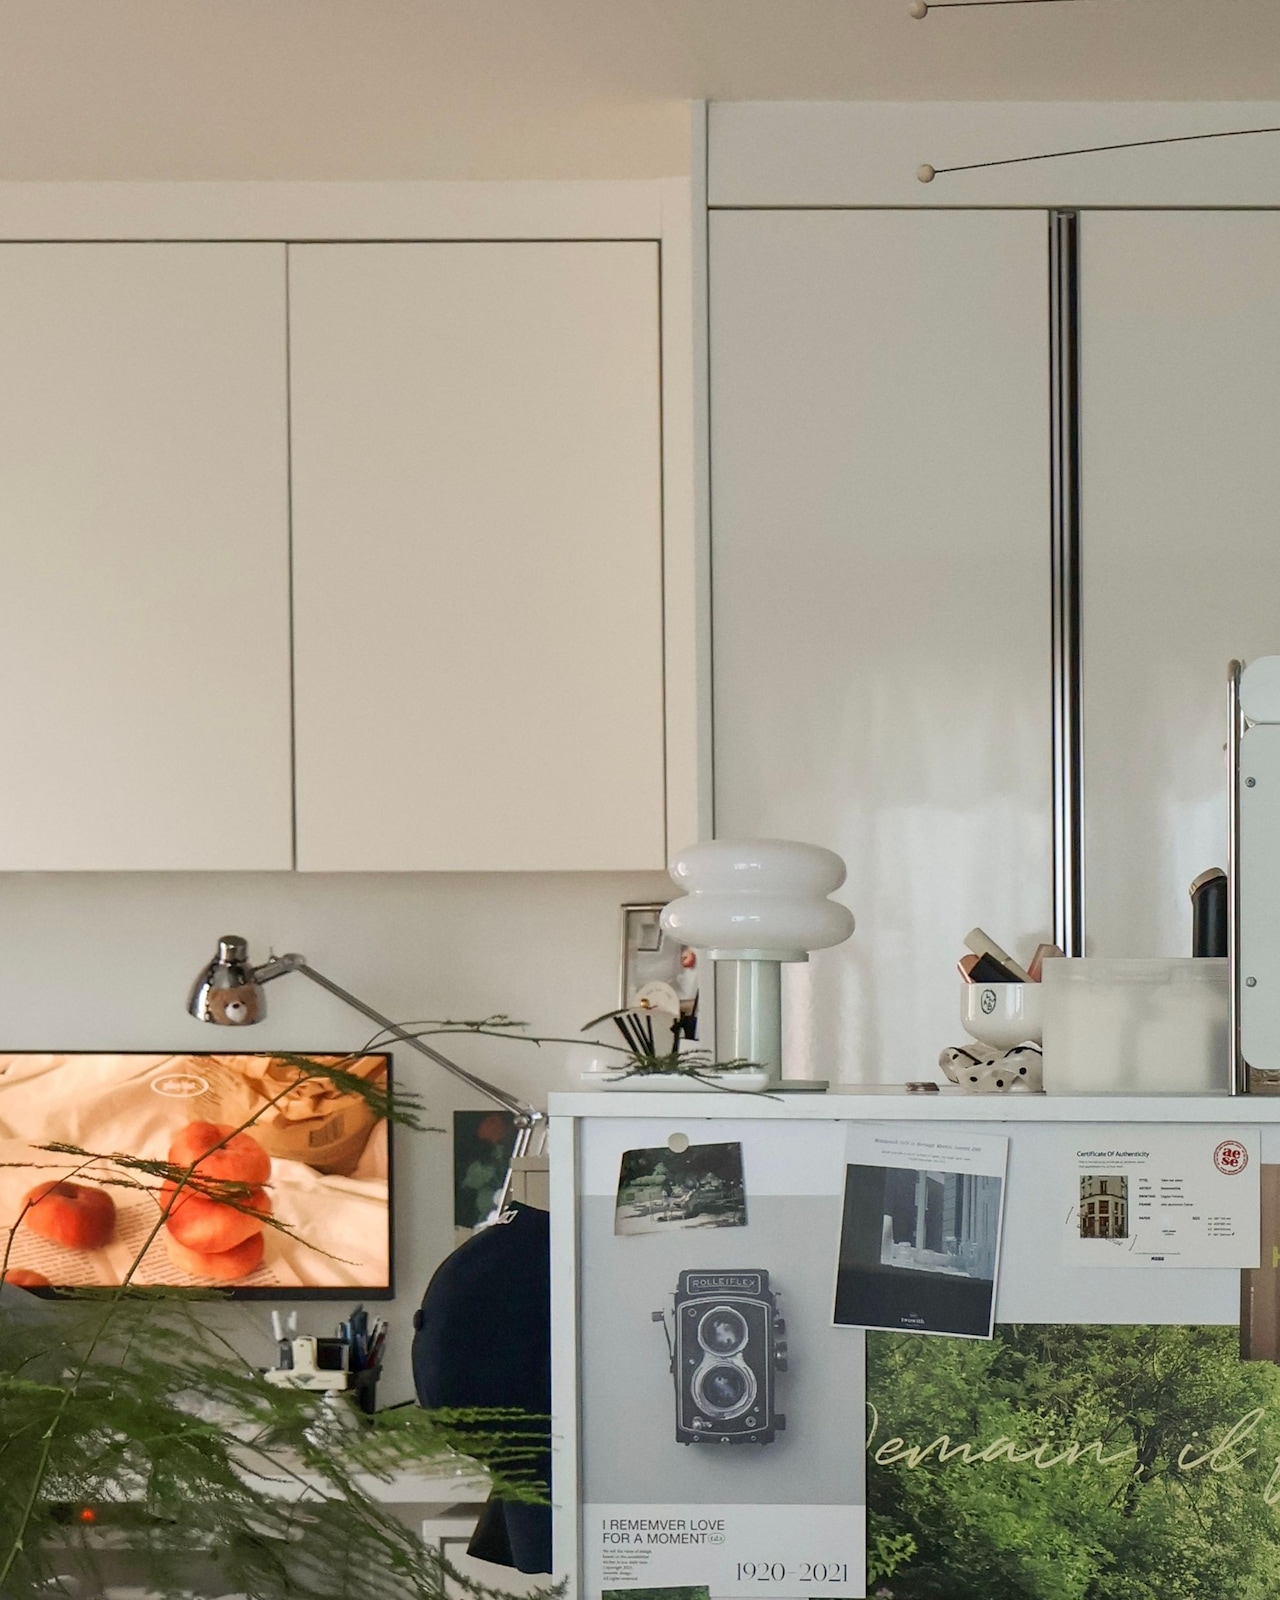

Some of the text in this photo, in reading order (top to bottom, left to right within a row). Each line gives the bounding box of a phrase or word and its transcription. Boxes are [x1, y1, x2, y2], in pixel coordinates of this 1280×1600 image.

[692, 1277, 756, 1288] ROLLEIFLEX
[866, 1402, 1144, 1477] emain,
[602, 1519, 726, 1531] I REMEMVER LOVE
[603, 1532, 630, 1544] FOR
[633, 1533, 643, 1544] A
[647, 1532, 708, 1545] MOMENT
